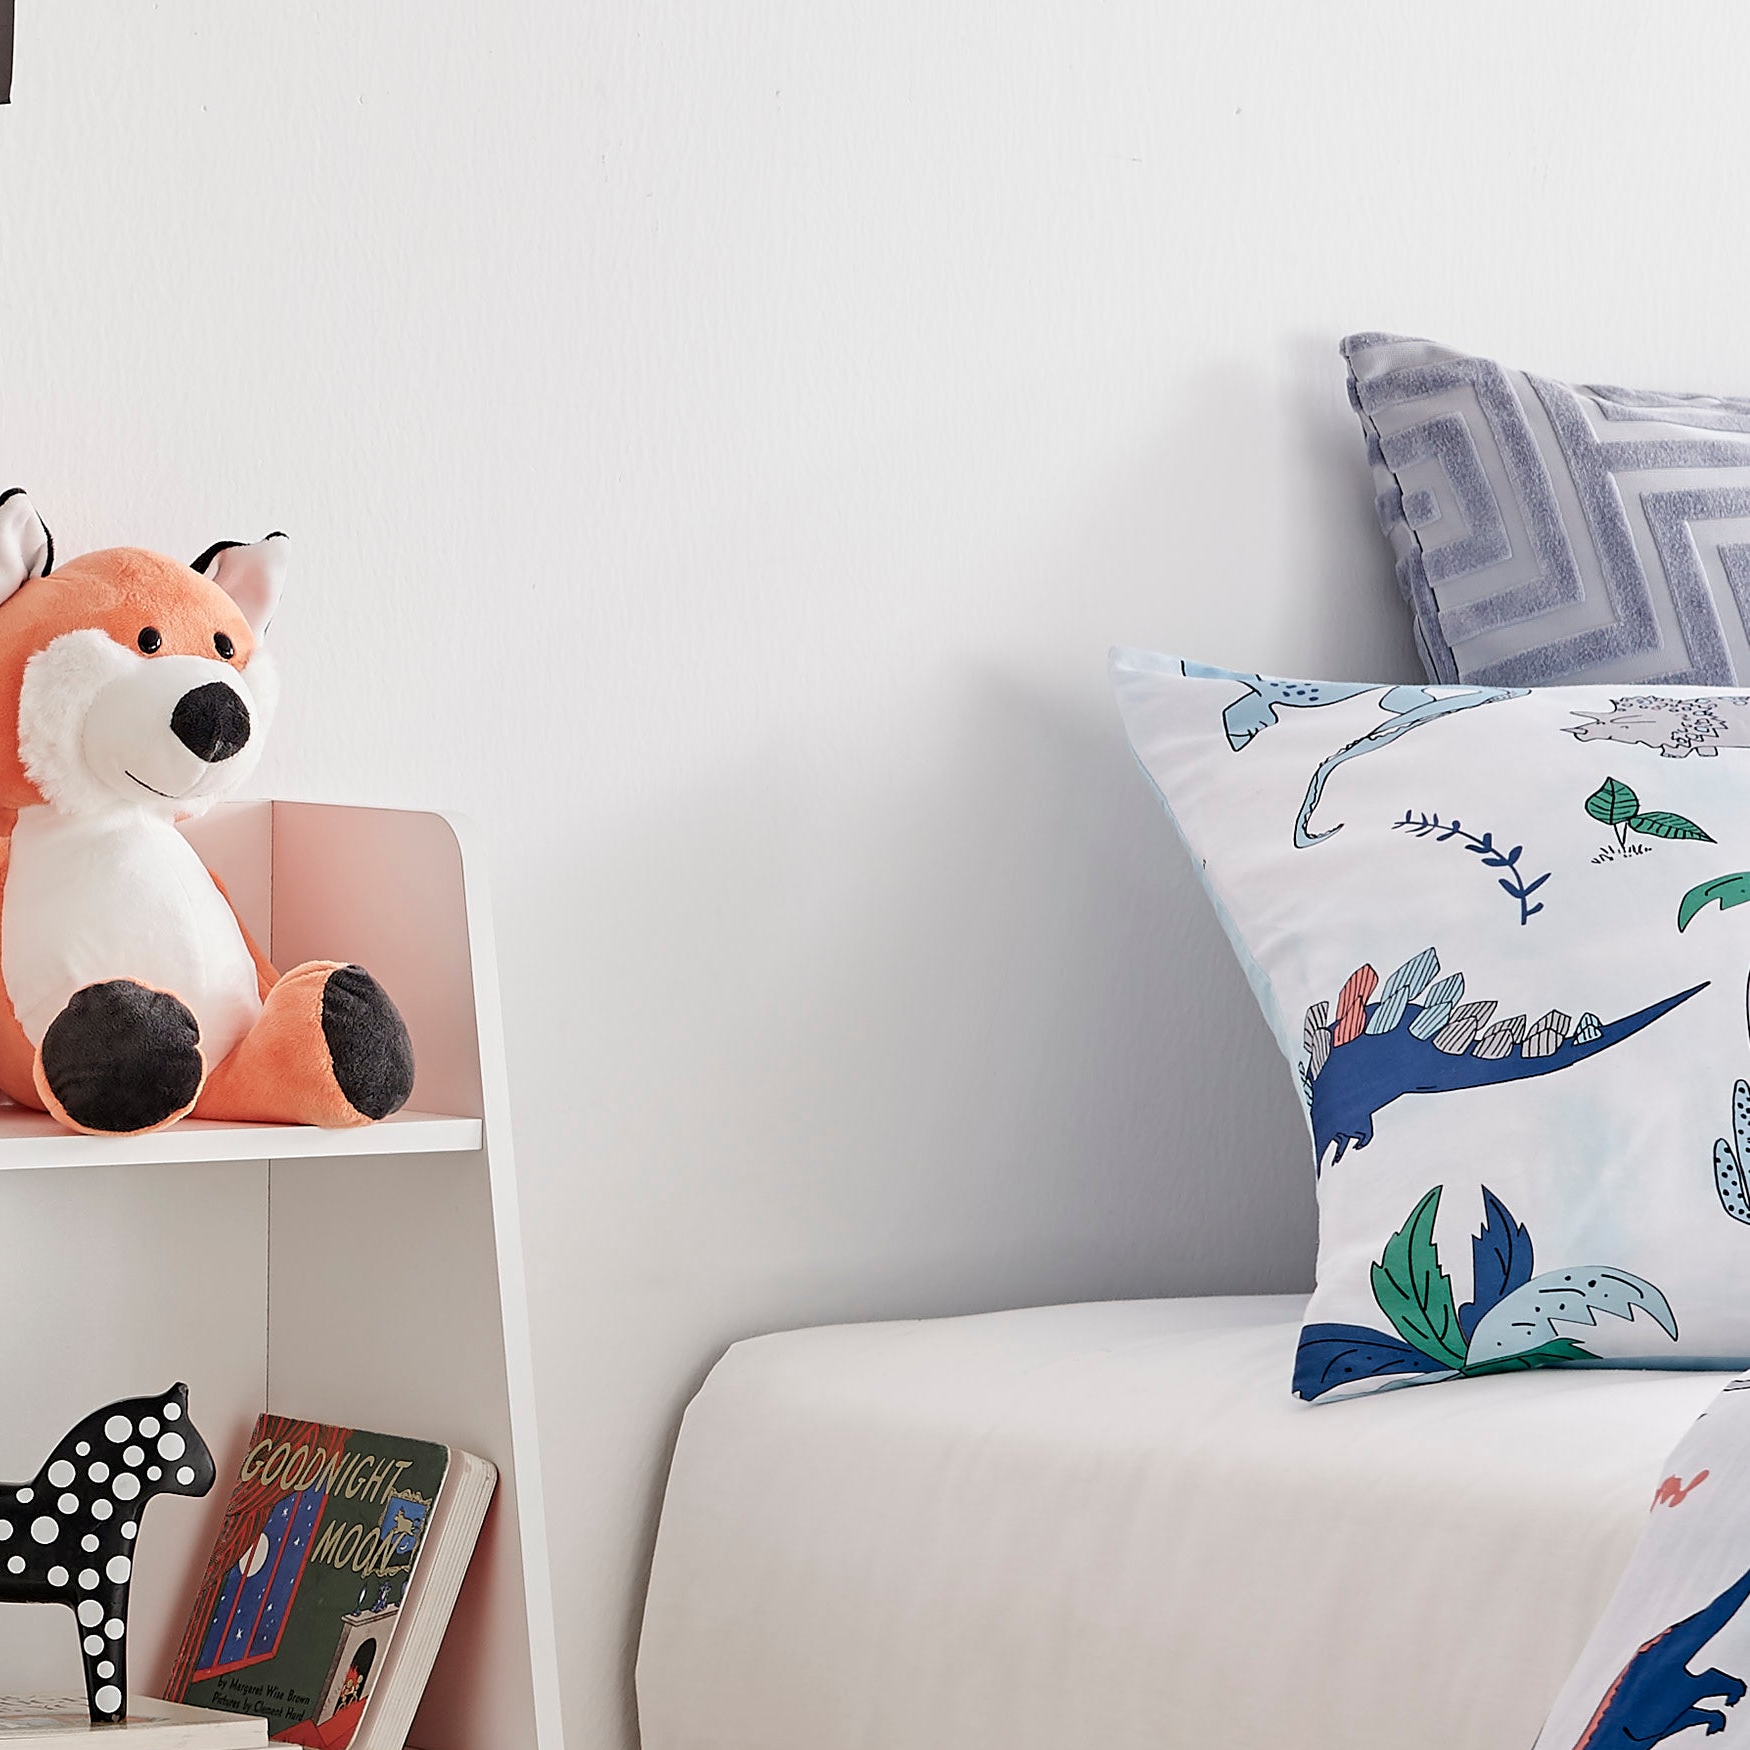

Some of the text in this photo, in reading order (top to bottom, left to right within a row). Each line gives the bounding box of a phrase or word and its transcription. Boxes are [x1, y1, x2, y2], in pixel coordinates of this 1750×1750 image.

[241, 1438, 413, 1505] GOODNIGHT
[310, 1519, 407, 1574] MOON
[211, 1691, 240, 1709] Pictures
[242, 1698, 252, 1713] by
[217, 1675, 311, 1705] by Margaret Wise Brown
